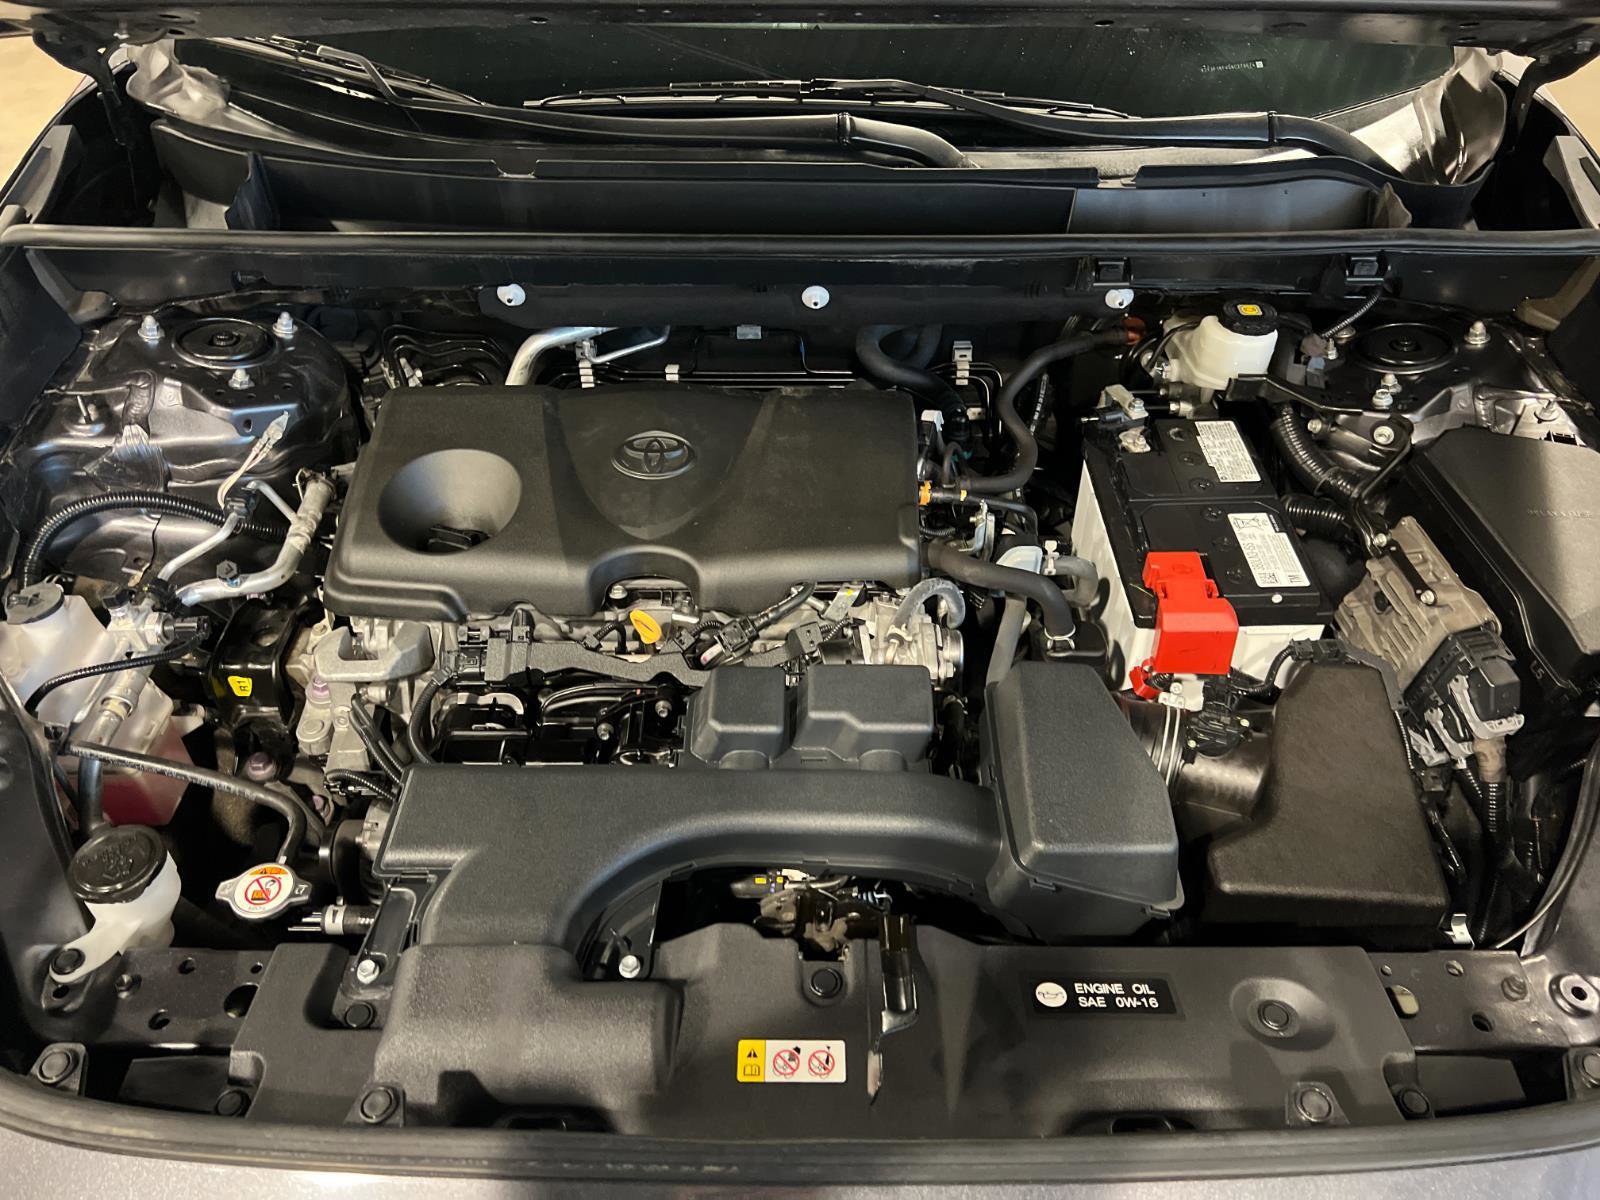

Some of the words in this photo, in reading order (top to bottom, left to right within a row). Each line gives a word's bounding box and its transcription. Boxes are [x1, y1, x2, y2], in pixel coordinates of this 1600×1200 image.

[1074, 983, 1125, 995] ENGINE
[1132, 984, 1156, 995] OIL
[1078, 997, 1107, 1008] SAE
[1115, 997, 1159, 1008] 0W-16
